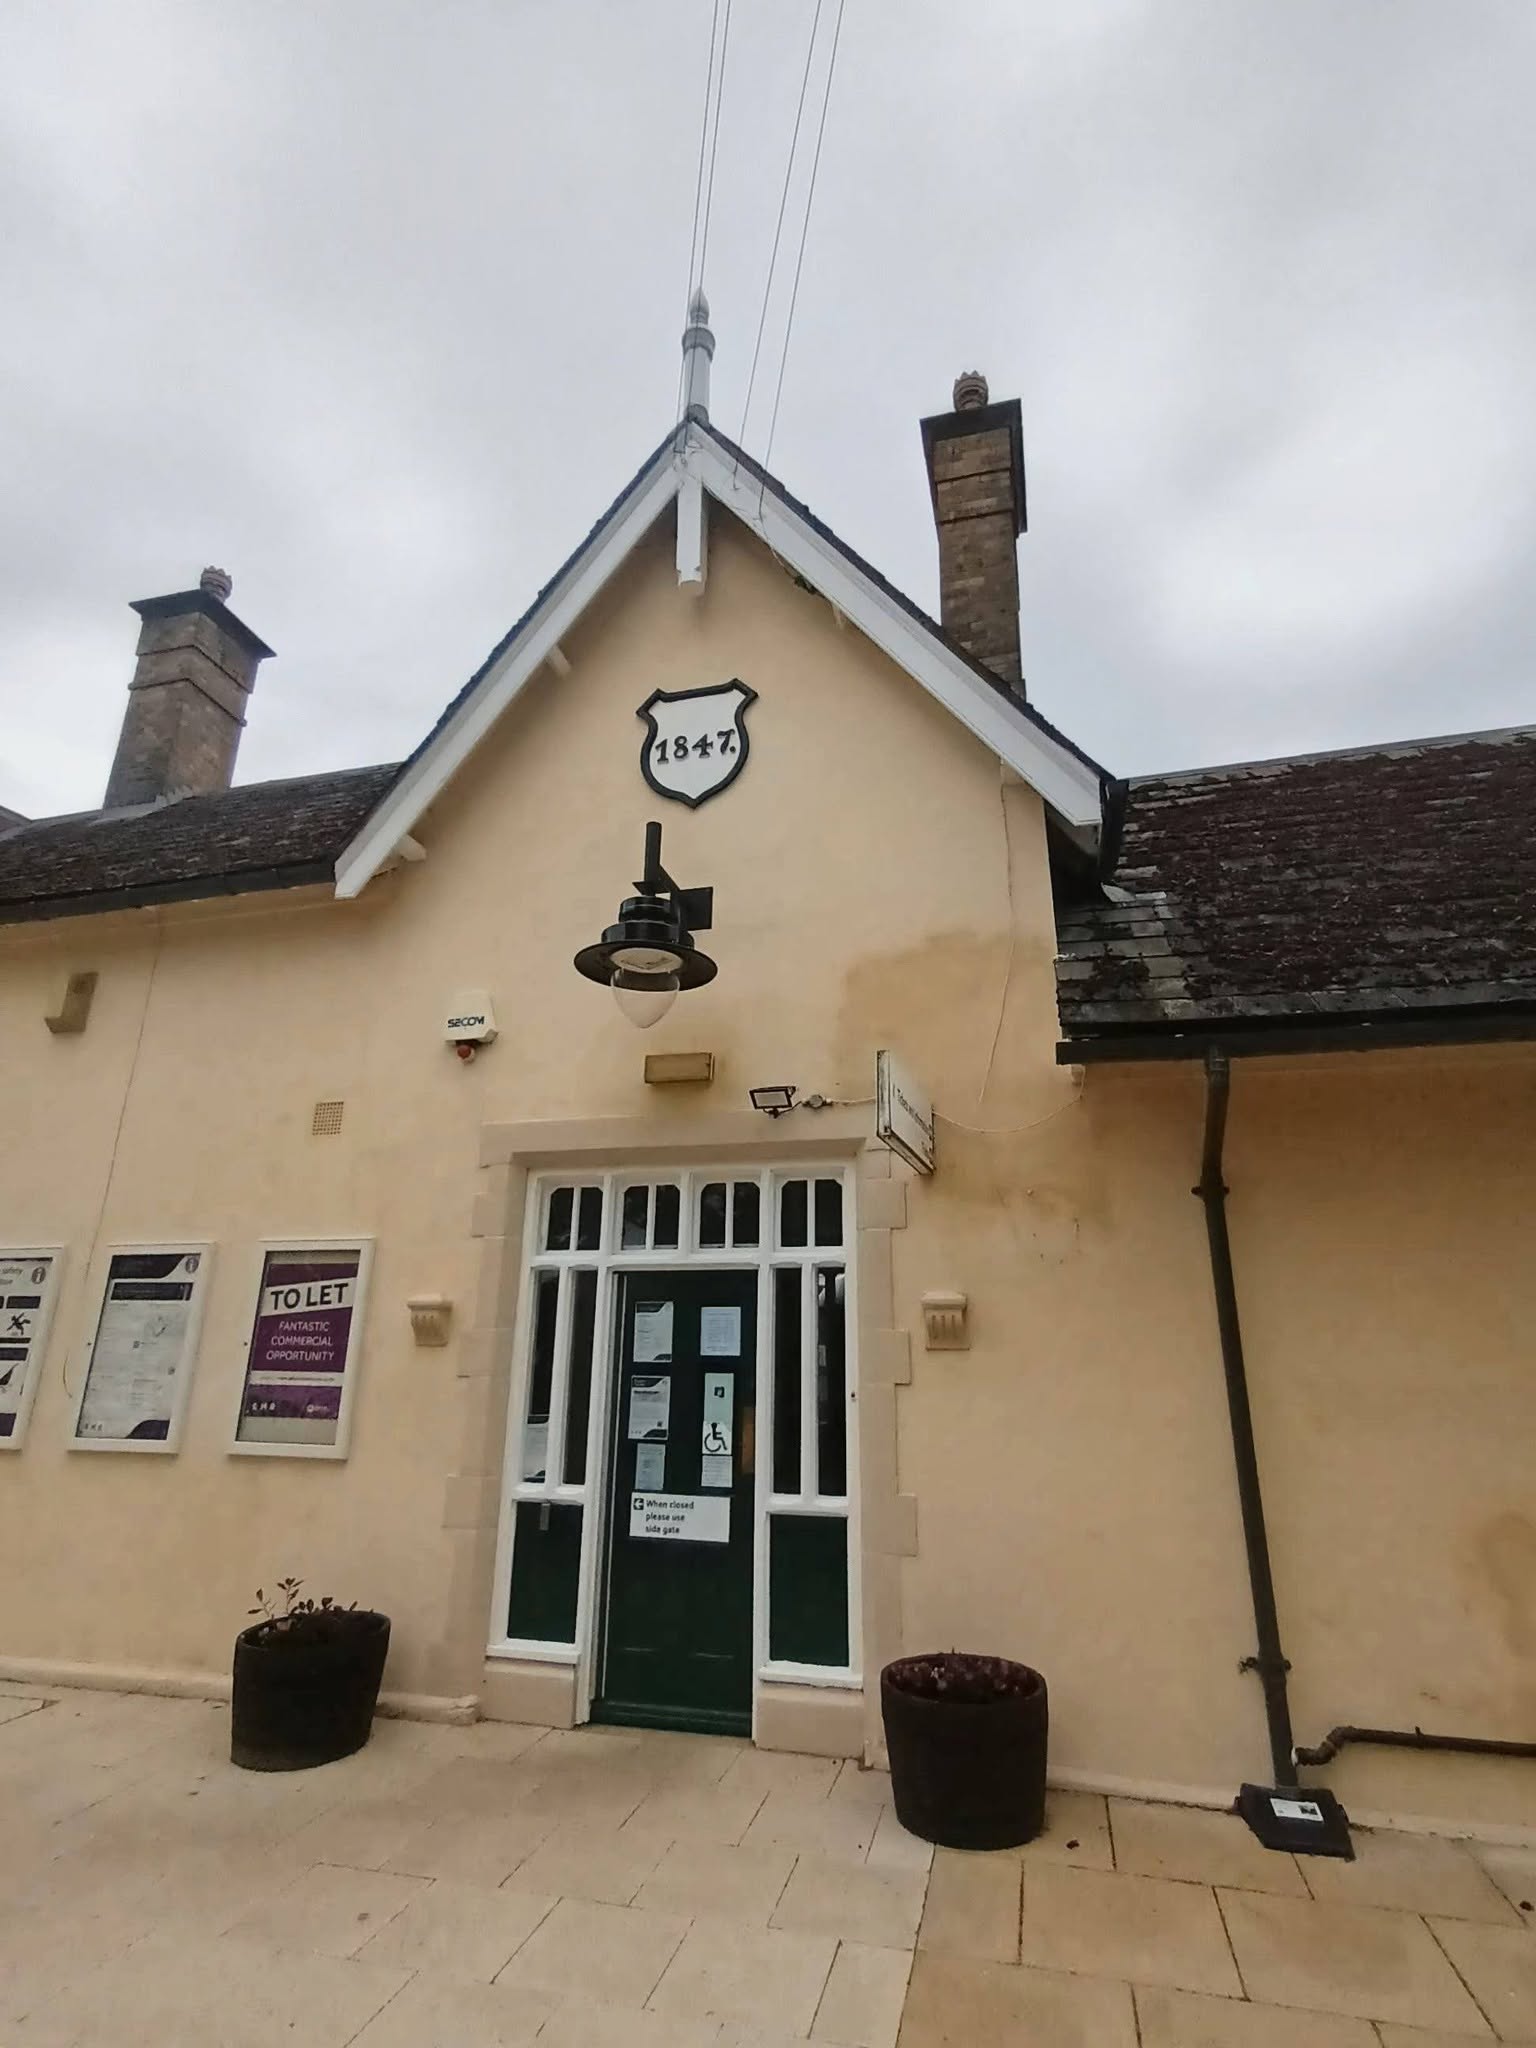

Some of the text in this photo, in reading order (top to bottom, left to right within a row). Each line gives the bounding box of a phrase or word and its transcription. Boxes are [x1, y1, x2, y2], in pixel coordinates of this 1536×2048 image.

[655, 728, 736, 765] 1847.
[447, 1015, 485, 1028] SECOM
[270, 1282, 349, 1310] TO LET
[279, 1320, 330, 1332] FANTASTIC
[271, 1335, 333, 1346] COMMERCIAL
[266, 1350, 335, 1361] OPPORTUNITY
[646, 1500, 695, 1509] When closed
[645, 1512, 670, 1522] please
[645, 1525, 680, 1535] side gate
